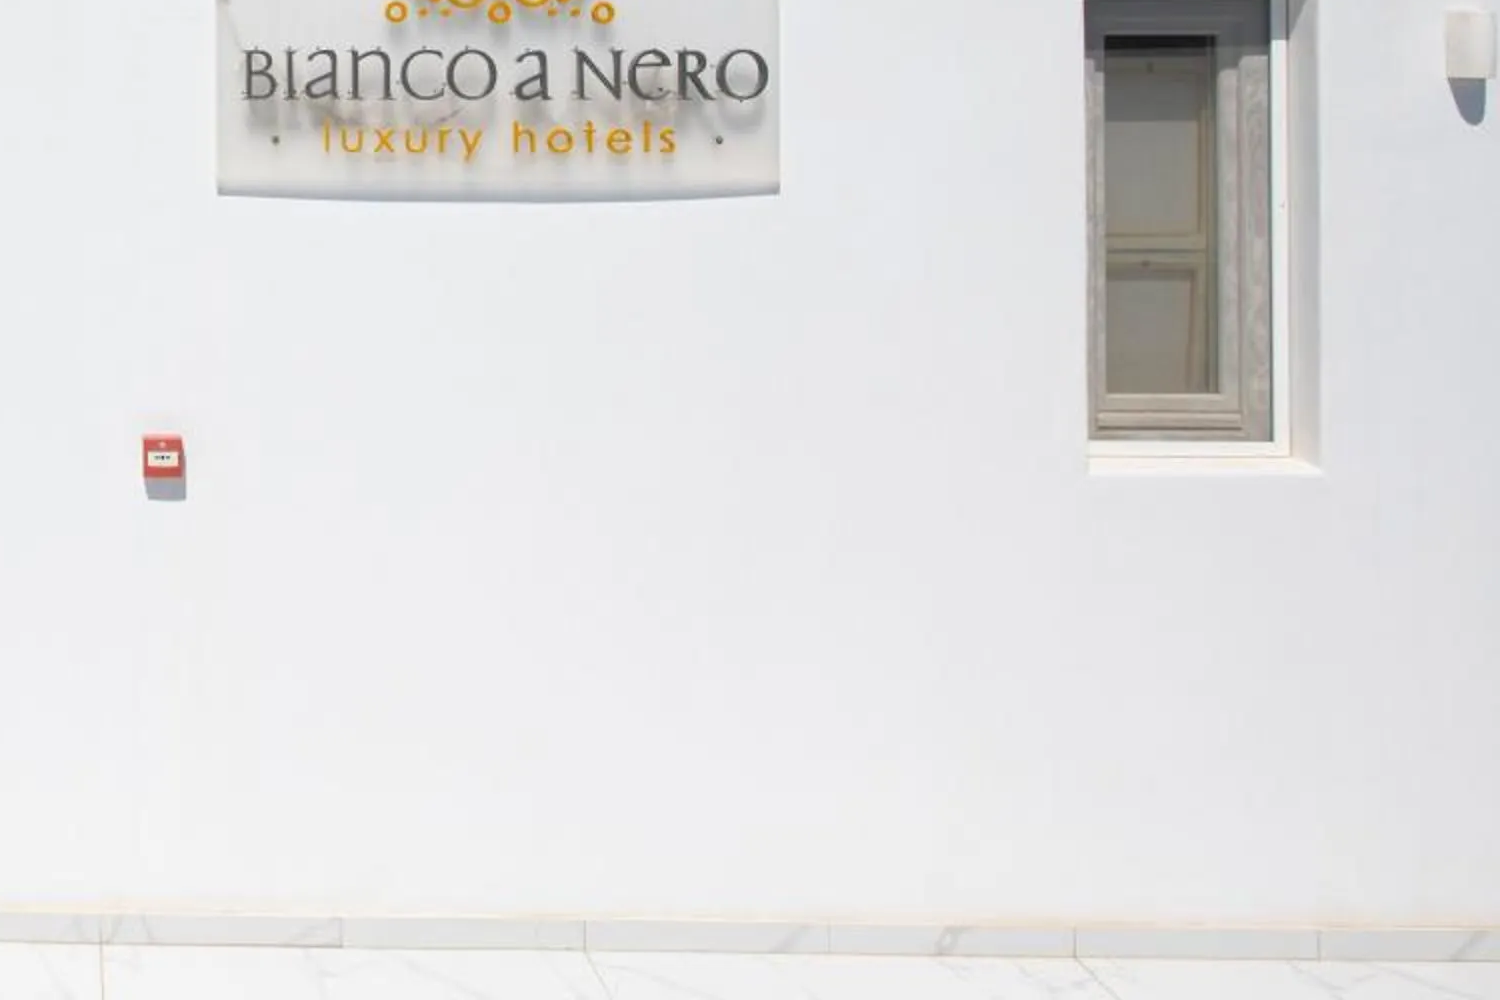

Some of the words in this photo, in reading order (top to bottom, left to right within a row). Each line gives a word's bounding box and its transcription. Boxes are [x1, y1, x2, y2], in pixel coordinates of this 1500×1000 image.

[513, 49, 551, 101] a
[322, 119, 483, 162] luxury
[512, 119, 677, 155] hotels
